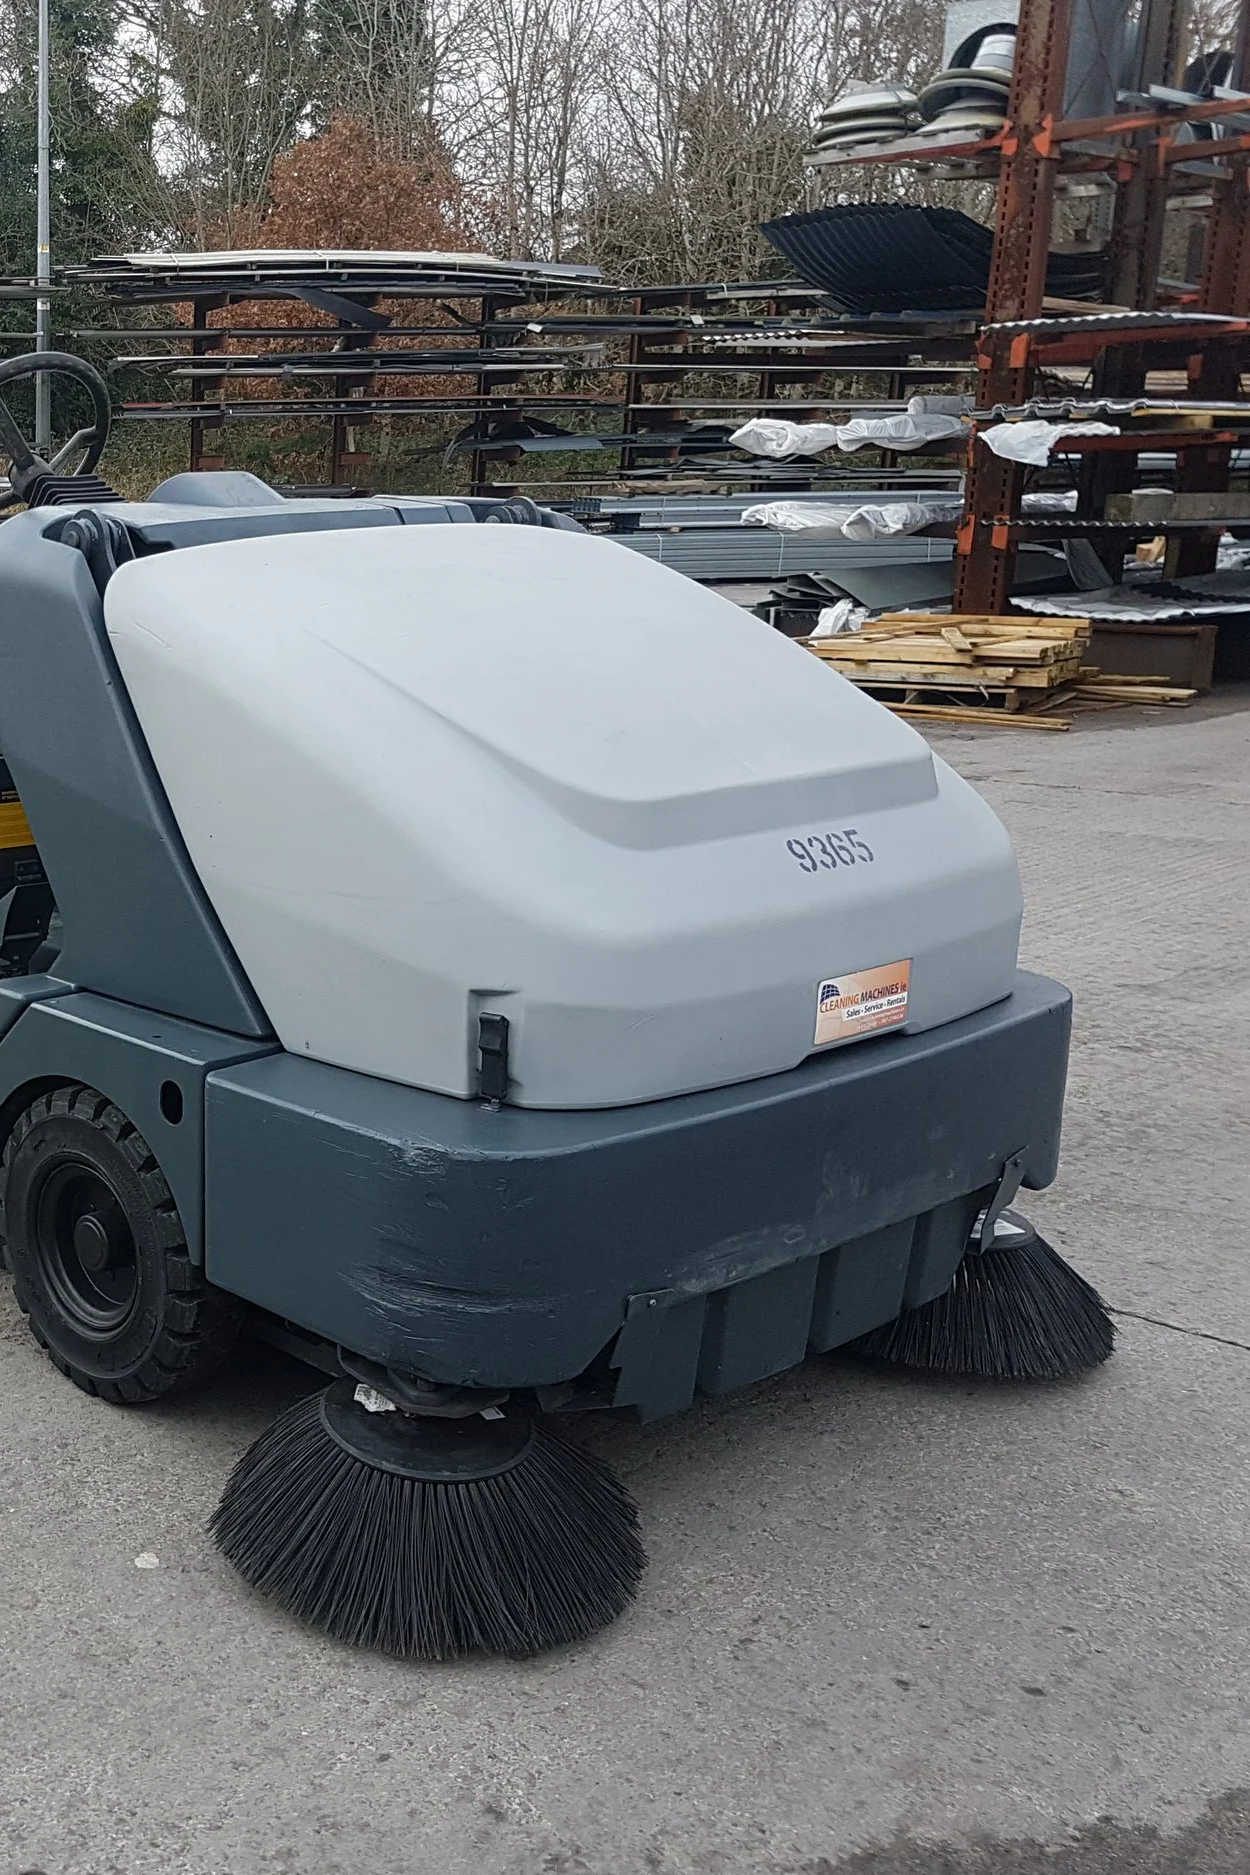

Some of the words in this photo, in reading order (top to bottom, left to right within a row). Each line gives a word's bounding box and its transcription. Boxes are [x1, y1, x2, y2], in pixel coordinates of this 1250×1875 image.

[786, 829, 875, 873] 9365
[820, 994, 860, 1014] CLEANING
[846, 1009, 861, 1019] Sales
[864, 1002, 884, 1014] Service
[886, 995, 906, 1008] Rentals
